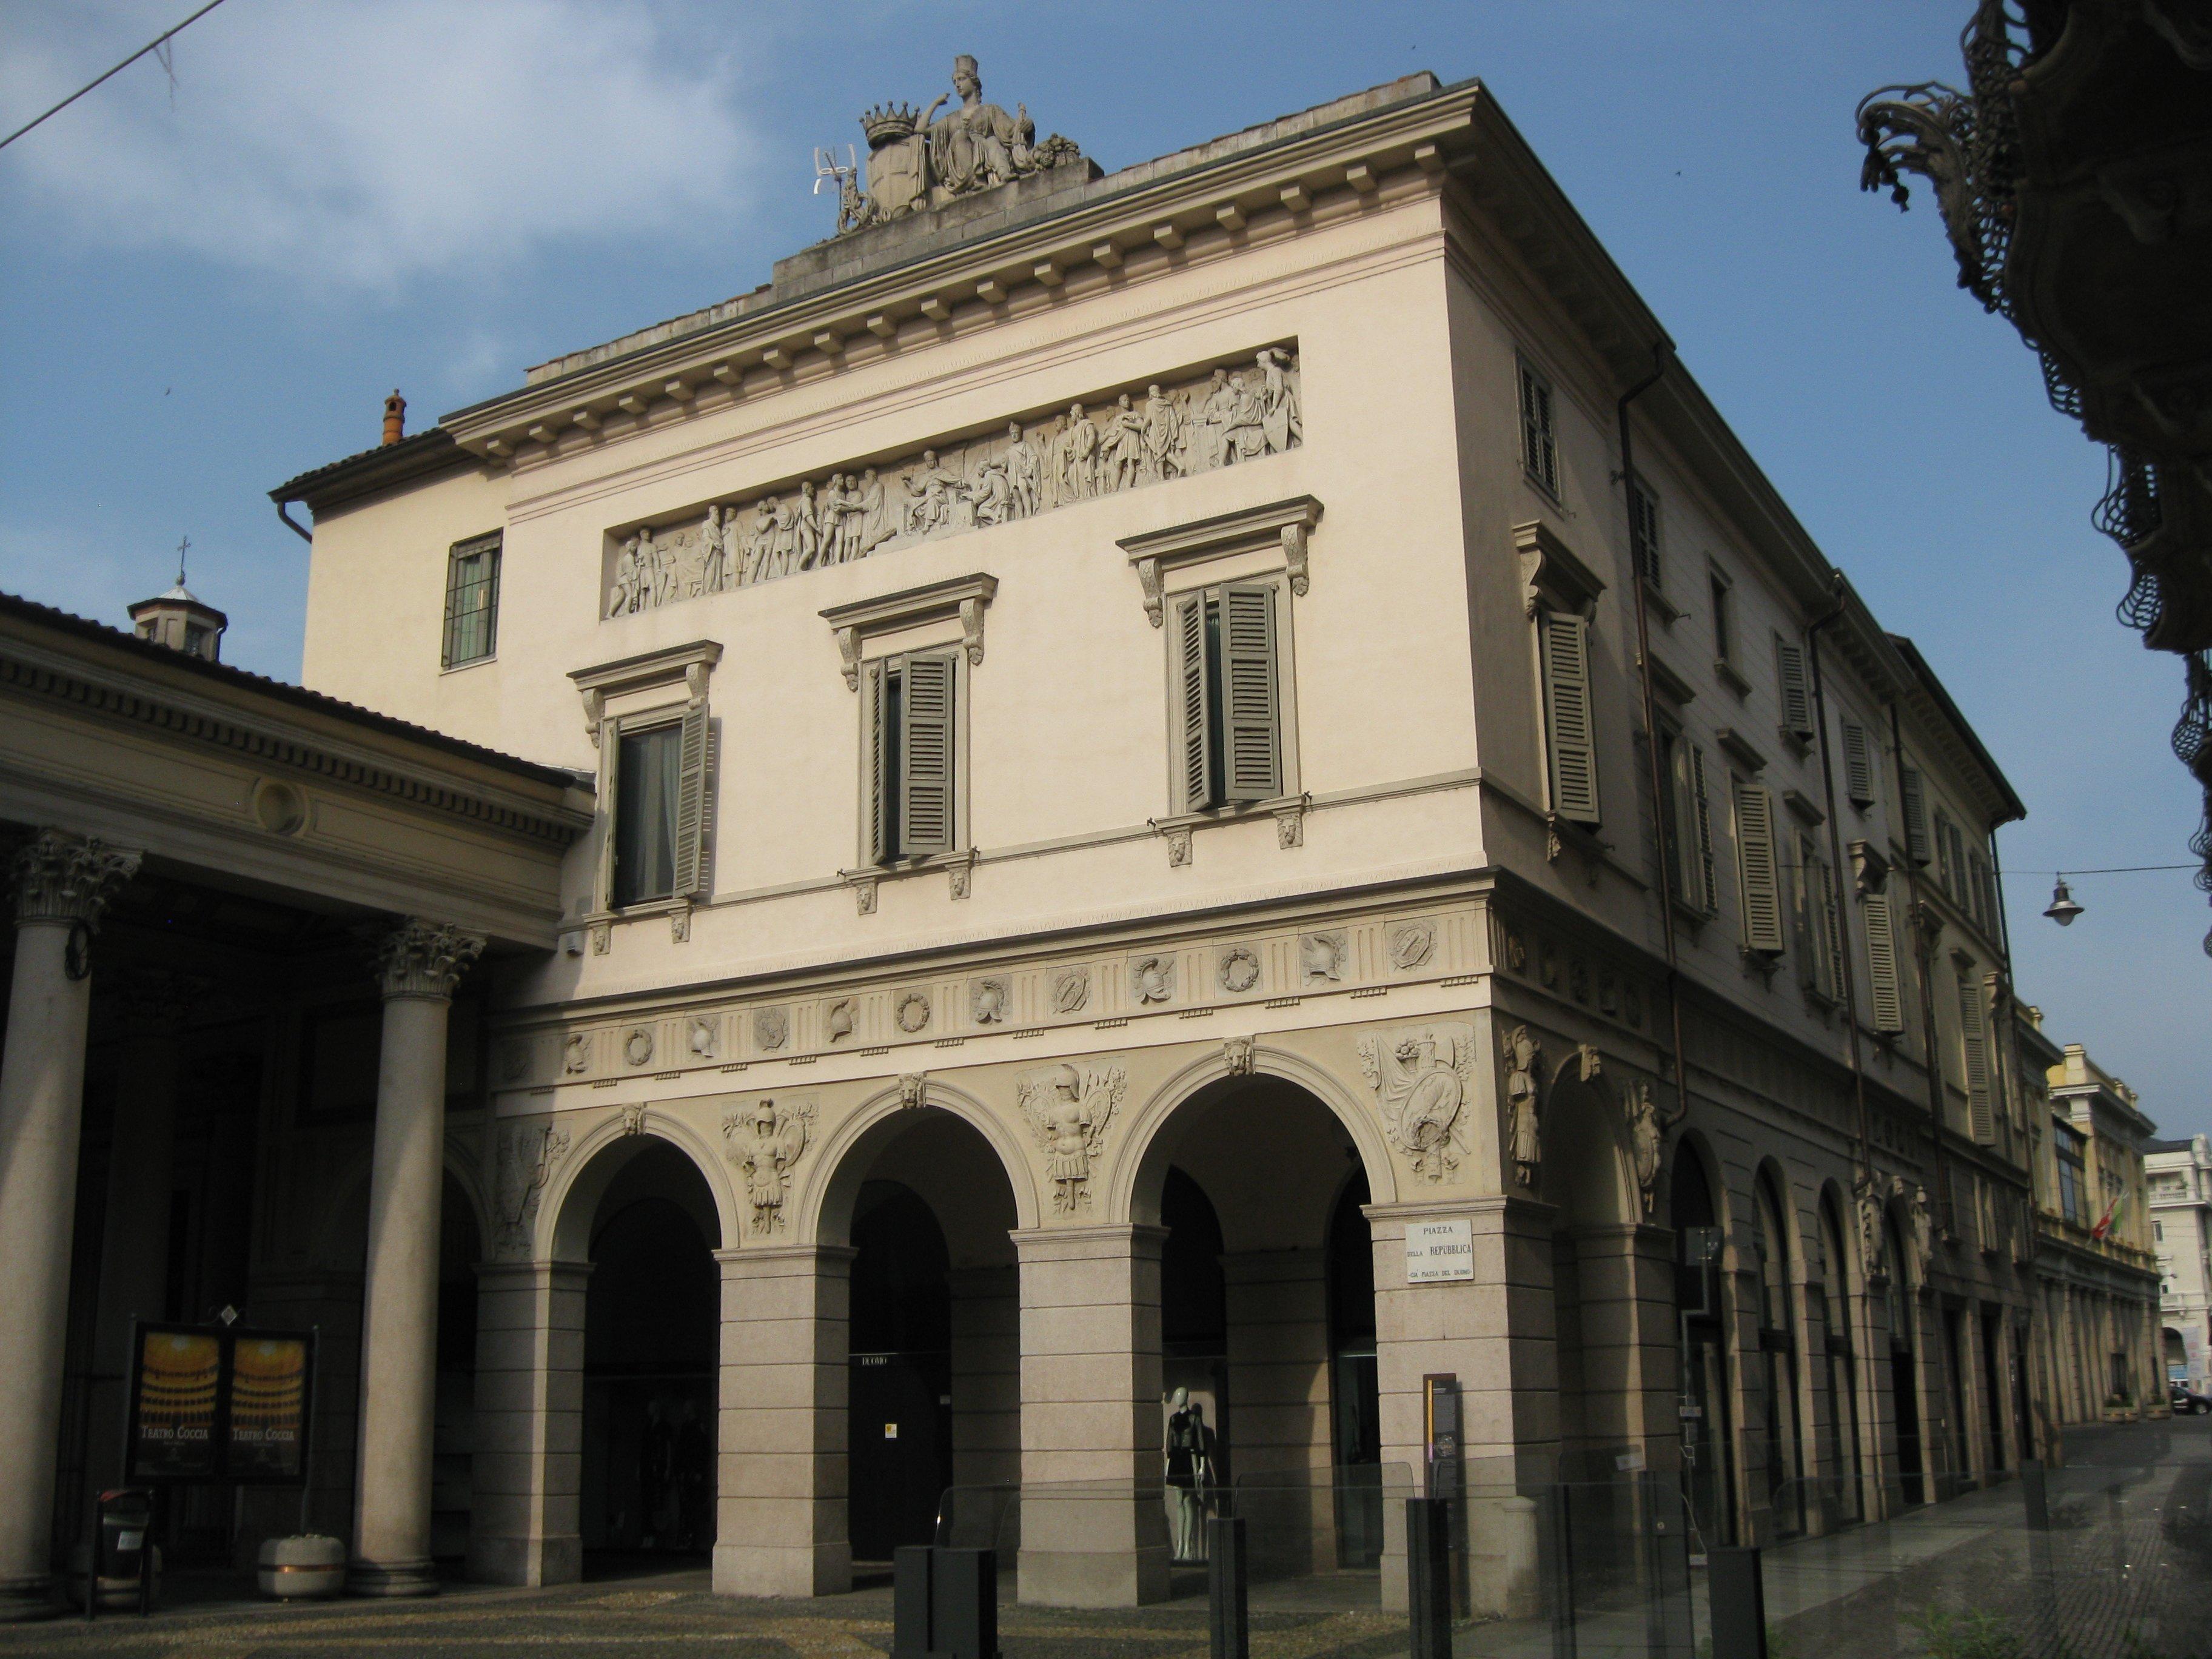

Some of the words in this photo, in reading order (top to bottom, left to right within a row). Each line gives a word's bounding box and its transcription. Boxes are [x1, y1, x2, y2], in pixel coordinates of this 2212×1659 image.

[1423, 1226, 1453, 1235] PIAZZA
[1430, 1244, 1472, 1256] REPUBBLICA
[141, 1425, 174, 1439] TEATRO
[177, 1426, 209, 1439] COCCIA
[233, 1427, 264, 1441] TEATRO
[266, 1428, 295, 1441] COCCIA
